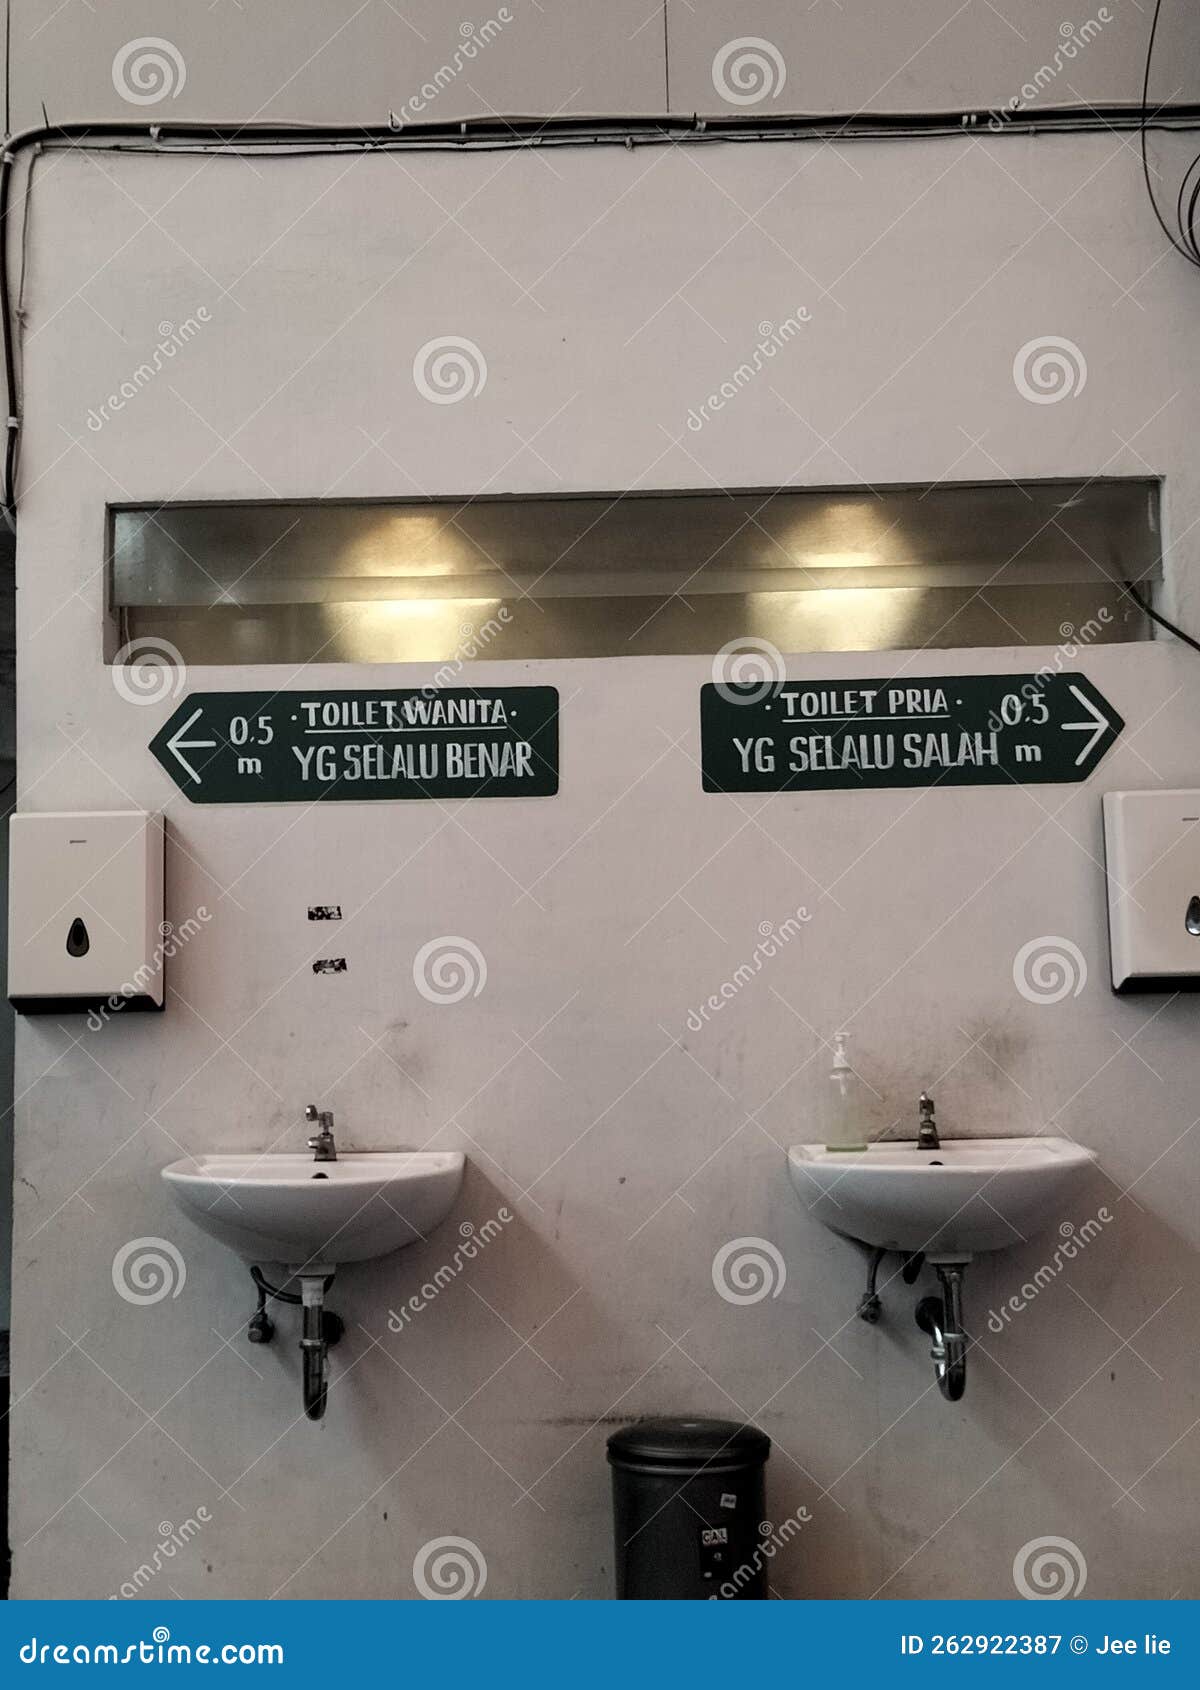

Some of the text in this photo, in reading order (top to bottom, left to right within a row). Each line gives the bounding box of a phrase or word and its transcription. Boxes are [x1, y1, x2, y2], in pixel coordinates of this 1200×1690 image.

[301, 698, 508, 727] TOILET WANITA
[782, 688, 948, 717] TOILET PRIA
[237, 755, 262, 774] m
[292, 740, 535, 781] YG SELALU BENAR
[732, 731, 999, 773] YG SELALU SALAH
[1014, 741, 1042, 763] m
